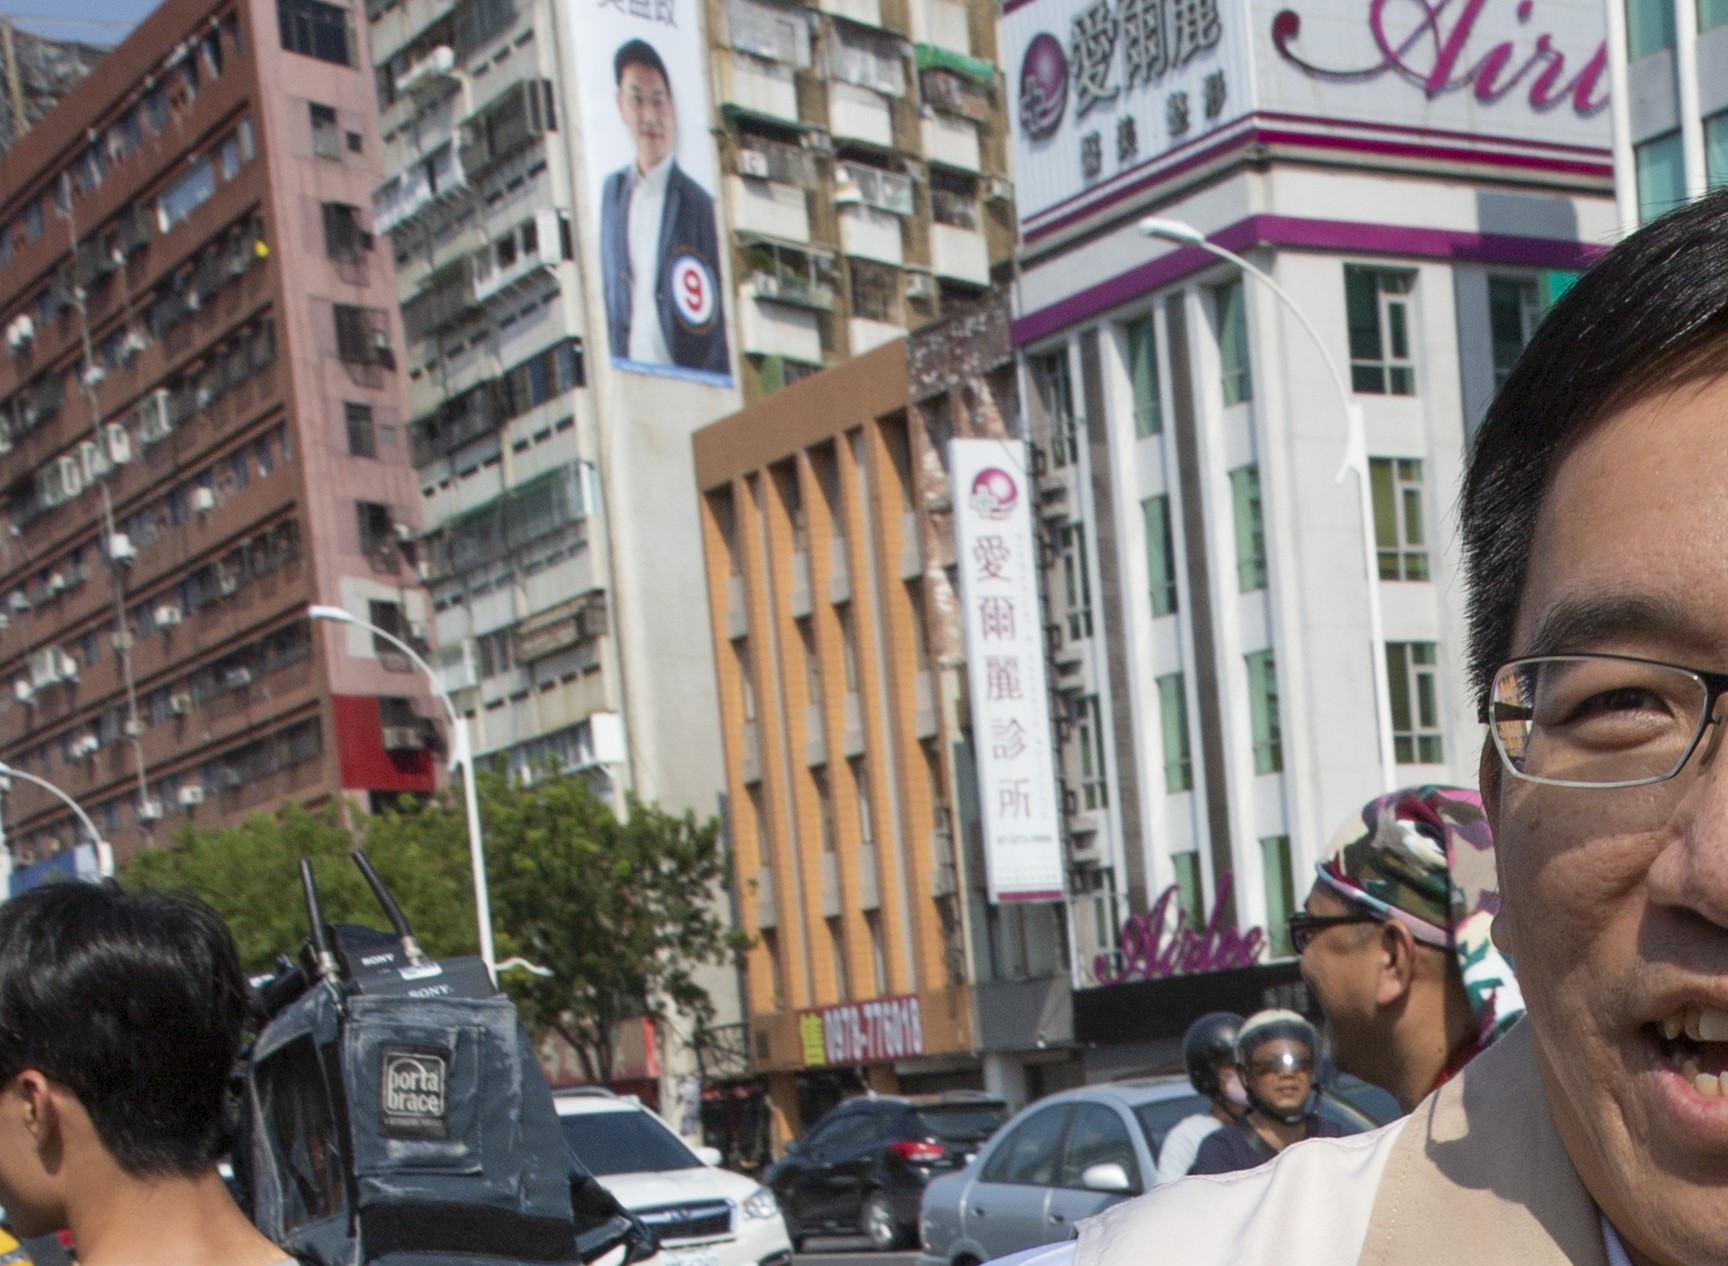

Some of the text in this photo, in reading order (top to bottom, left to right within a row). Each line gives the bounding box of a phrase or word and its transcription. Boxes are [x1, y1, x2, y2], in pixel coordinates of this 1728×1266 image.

[683, 268, 703, 312] 9
[973, 534, 1031, 819] 愛爾麗診所
[361, 952, 395, 967] SONY
[389, 1069, 440, 1092] porta
[388, 1090, 441, 1113] brace
